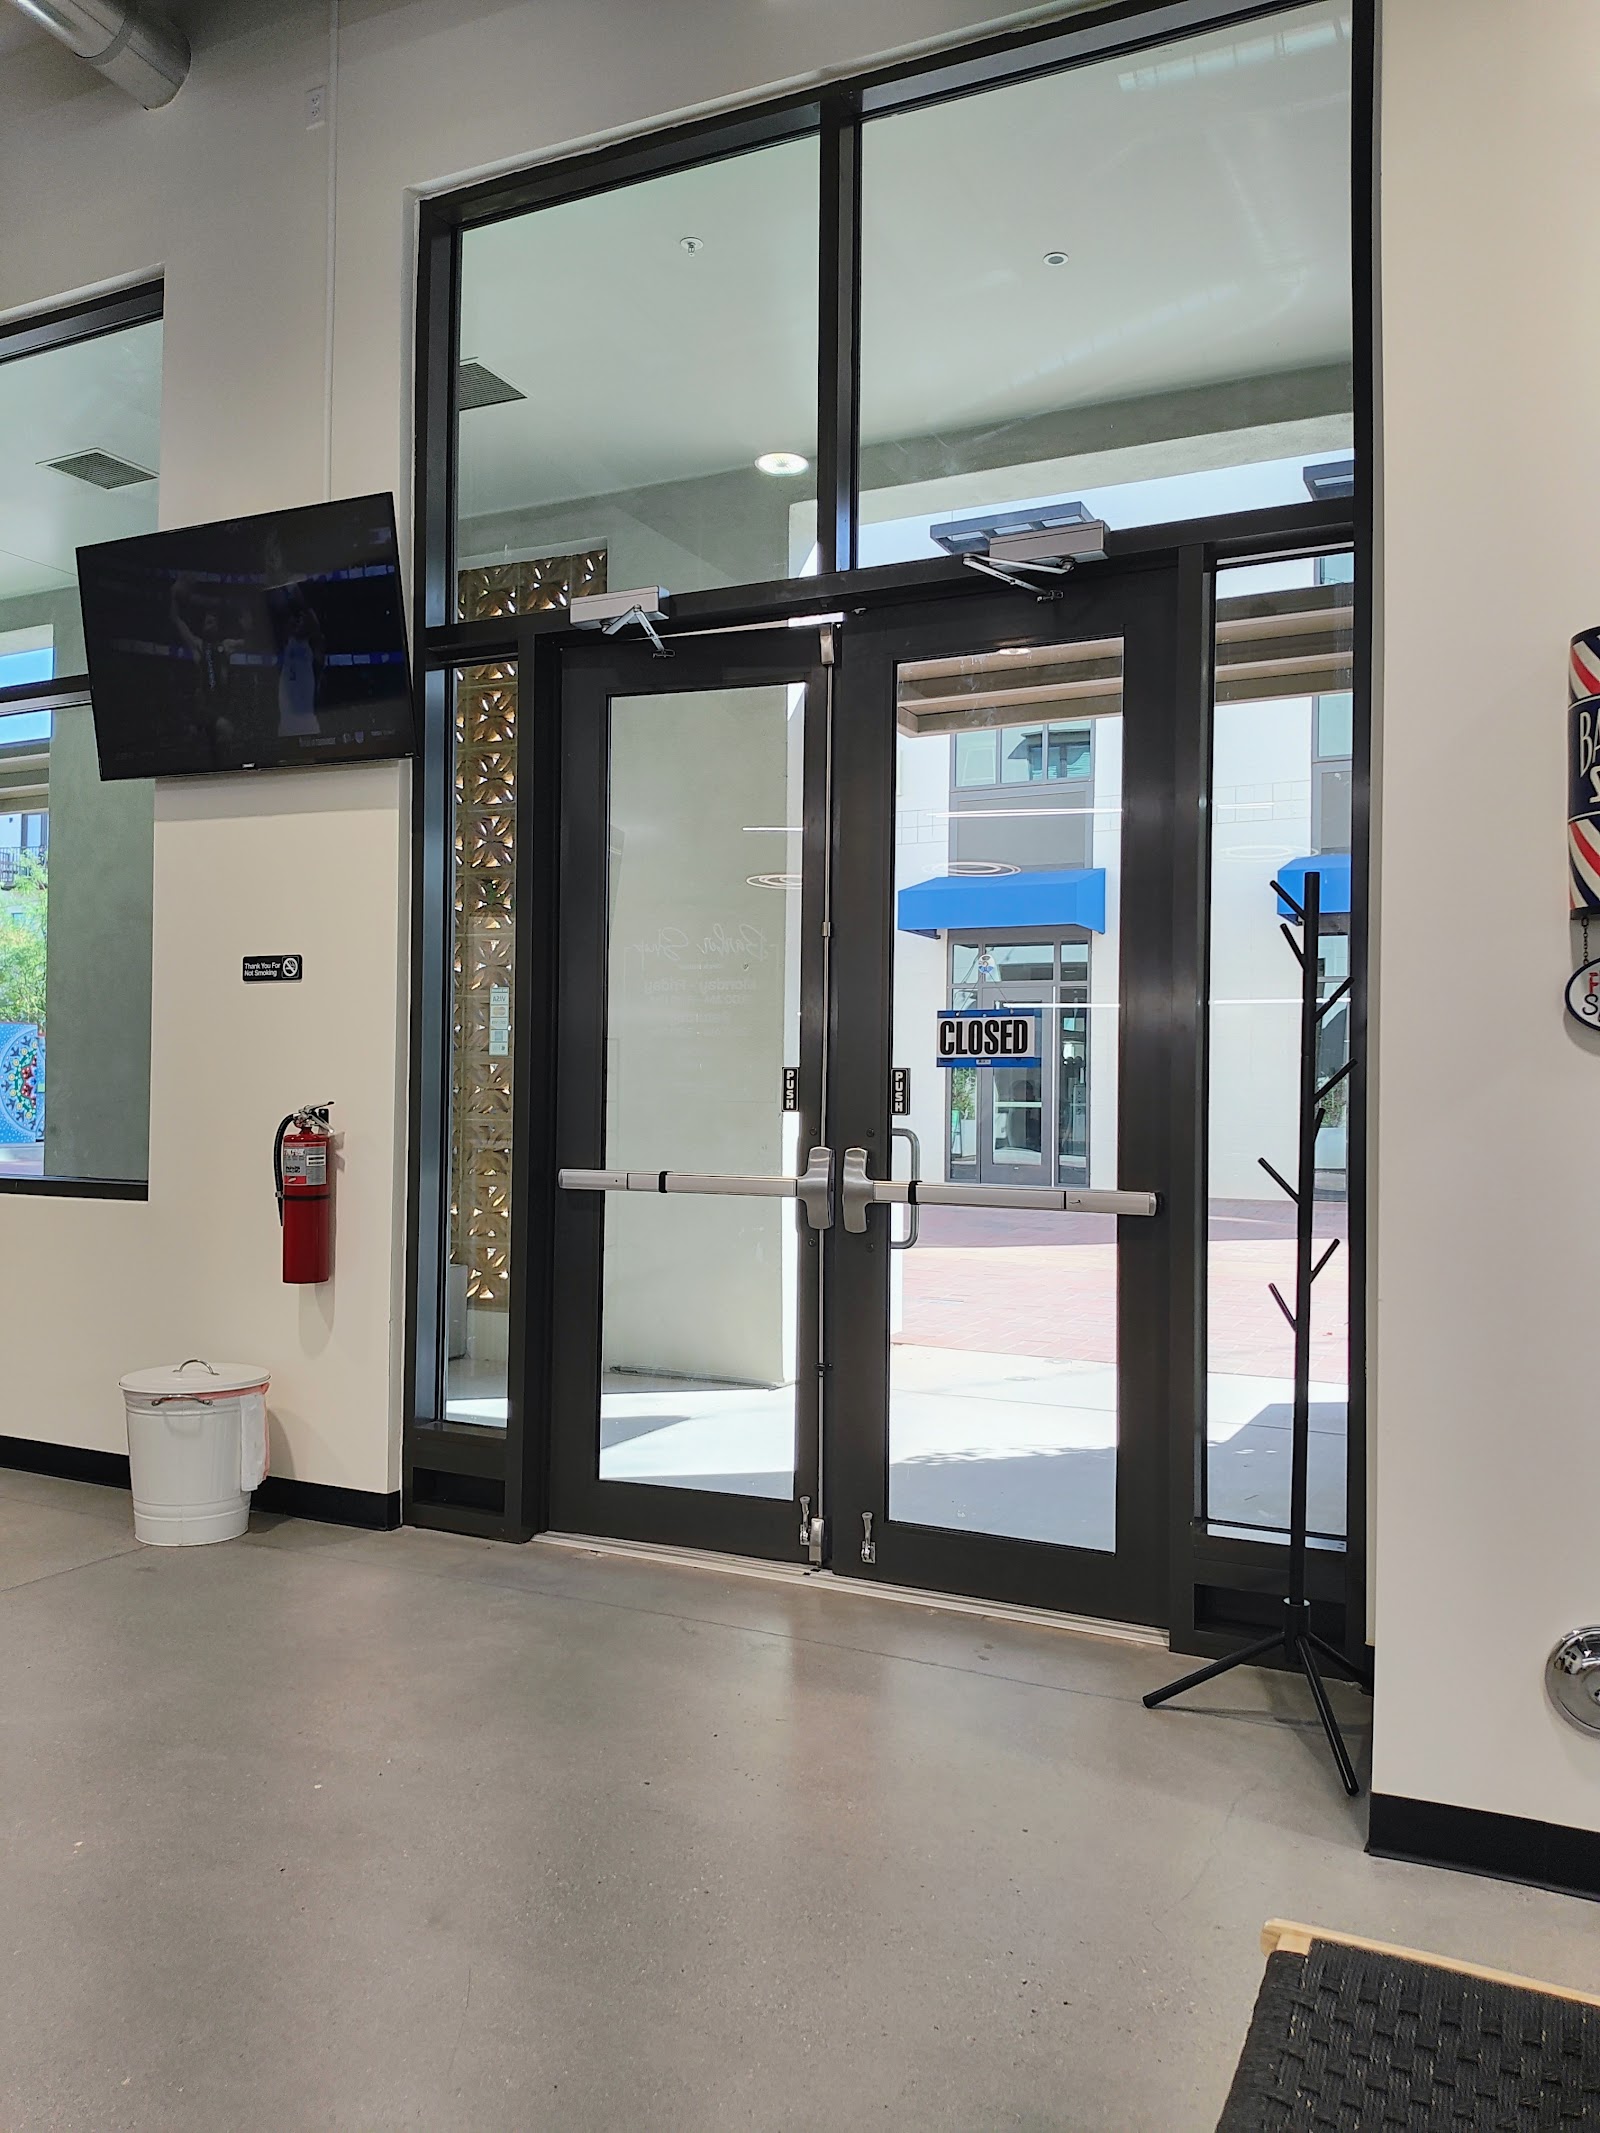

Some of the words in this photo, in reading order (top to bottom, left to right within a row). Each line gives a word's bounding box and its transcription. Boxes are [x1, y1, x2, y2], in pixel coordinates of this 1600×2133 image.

[244, 962, 260, 970] Thank
[254, 969, 277, 978] Smoking
[940, 1019, 1028, 1055] CLOSED
[786, 1070, 795, 1109] PUSH
[894, 1071, 904, 1112] PUSH
